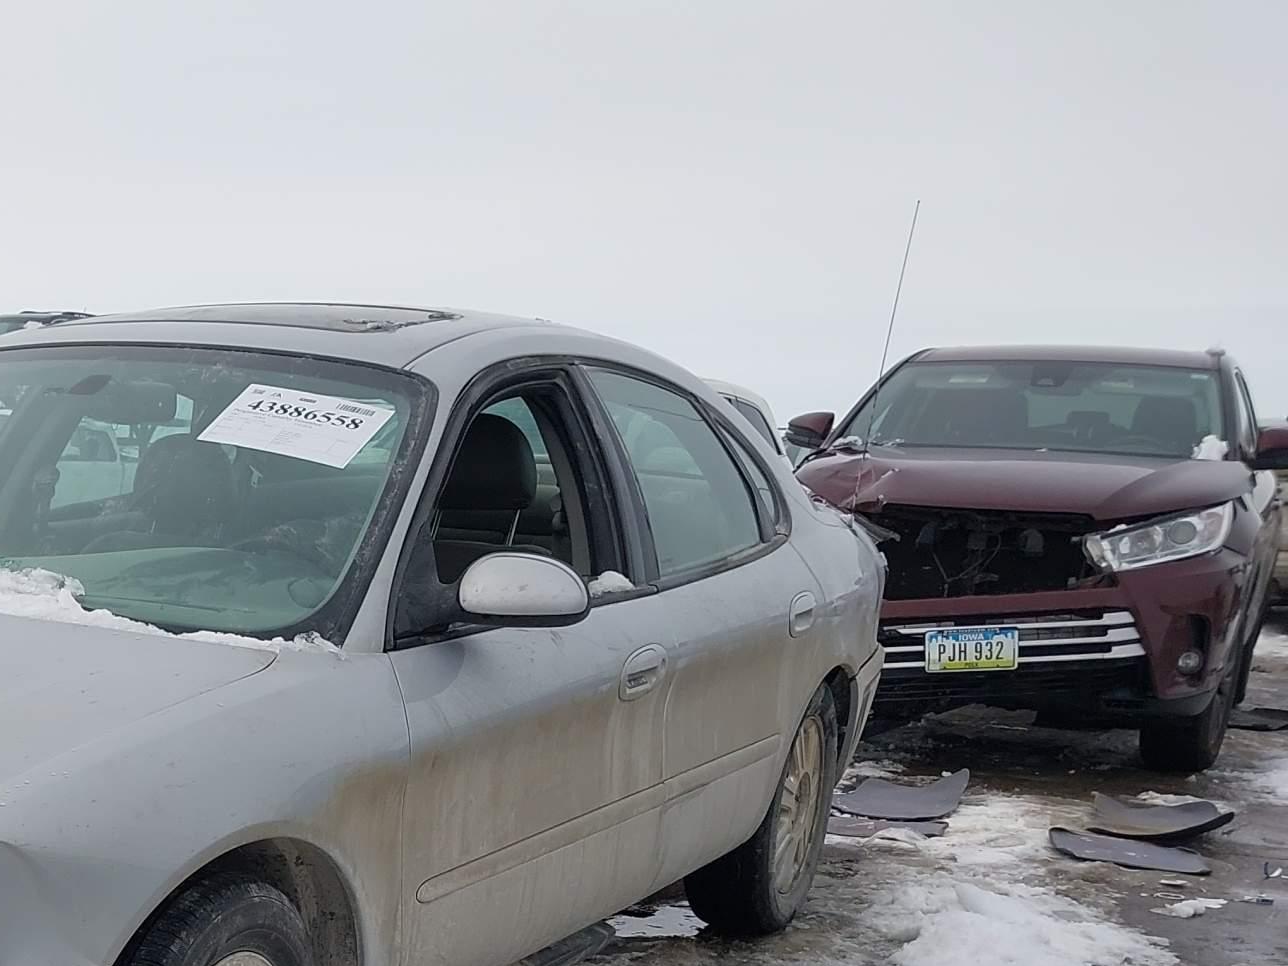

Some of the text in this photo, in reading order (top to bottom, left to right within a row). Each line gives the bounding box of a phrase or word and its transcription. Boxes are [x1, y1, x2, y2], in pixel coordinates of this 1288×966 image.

[247, 400, 363, 430] 43886558
[938, 641, 1003, 662] PJH 932
